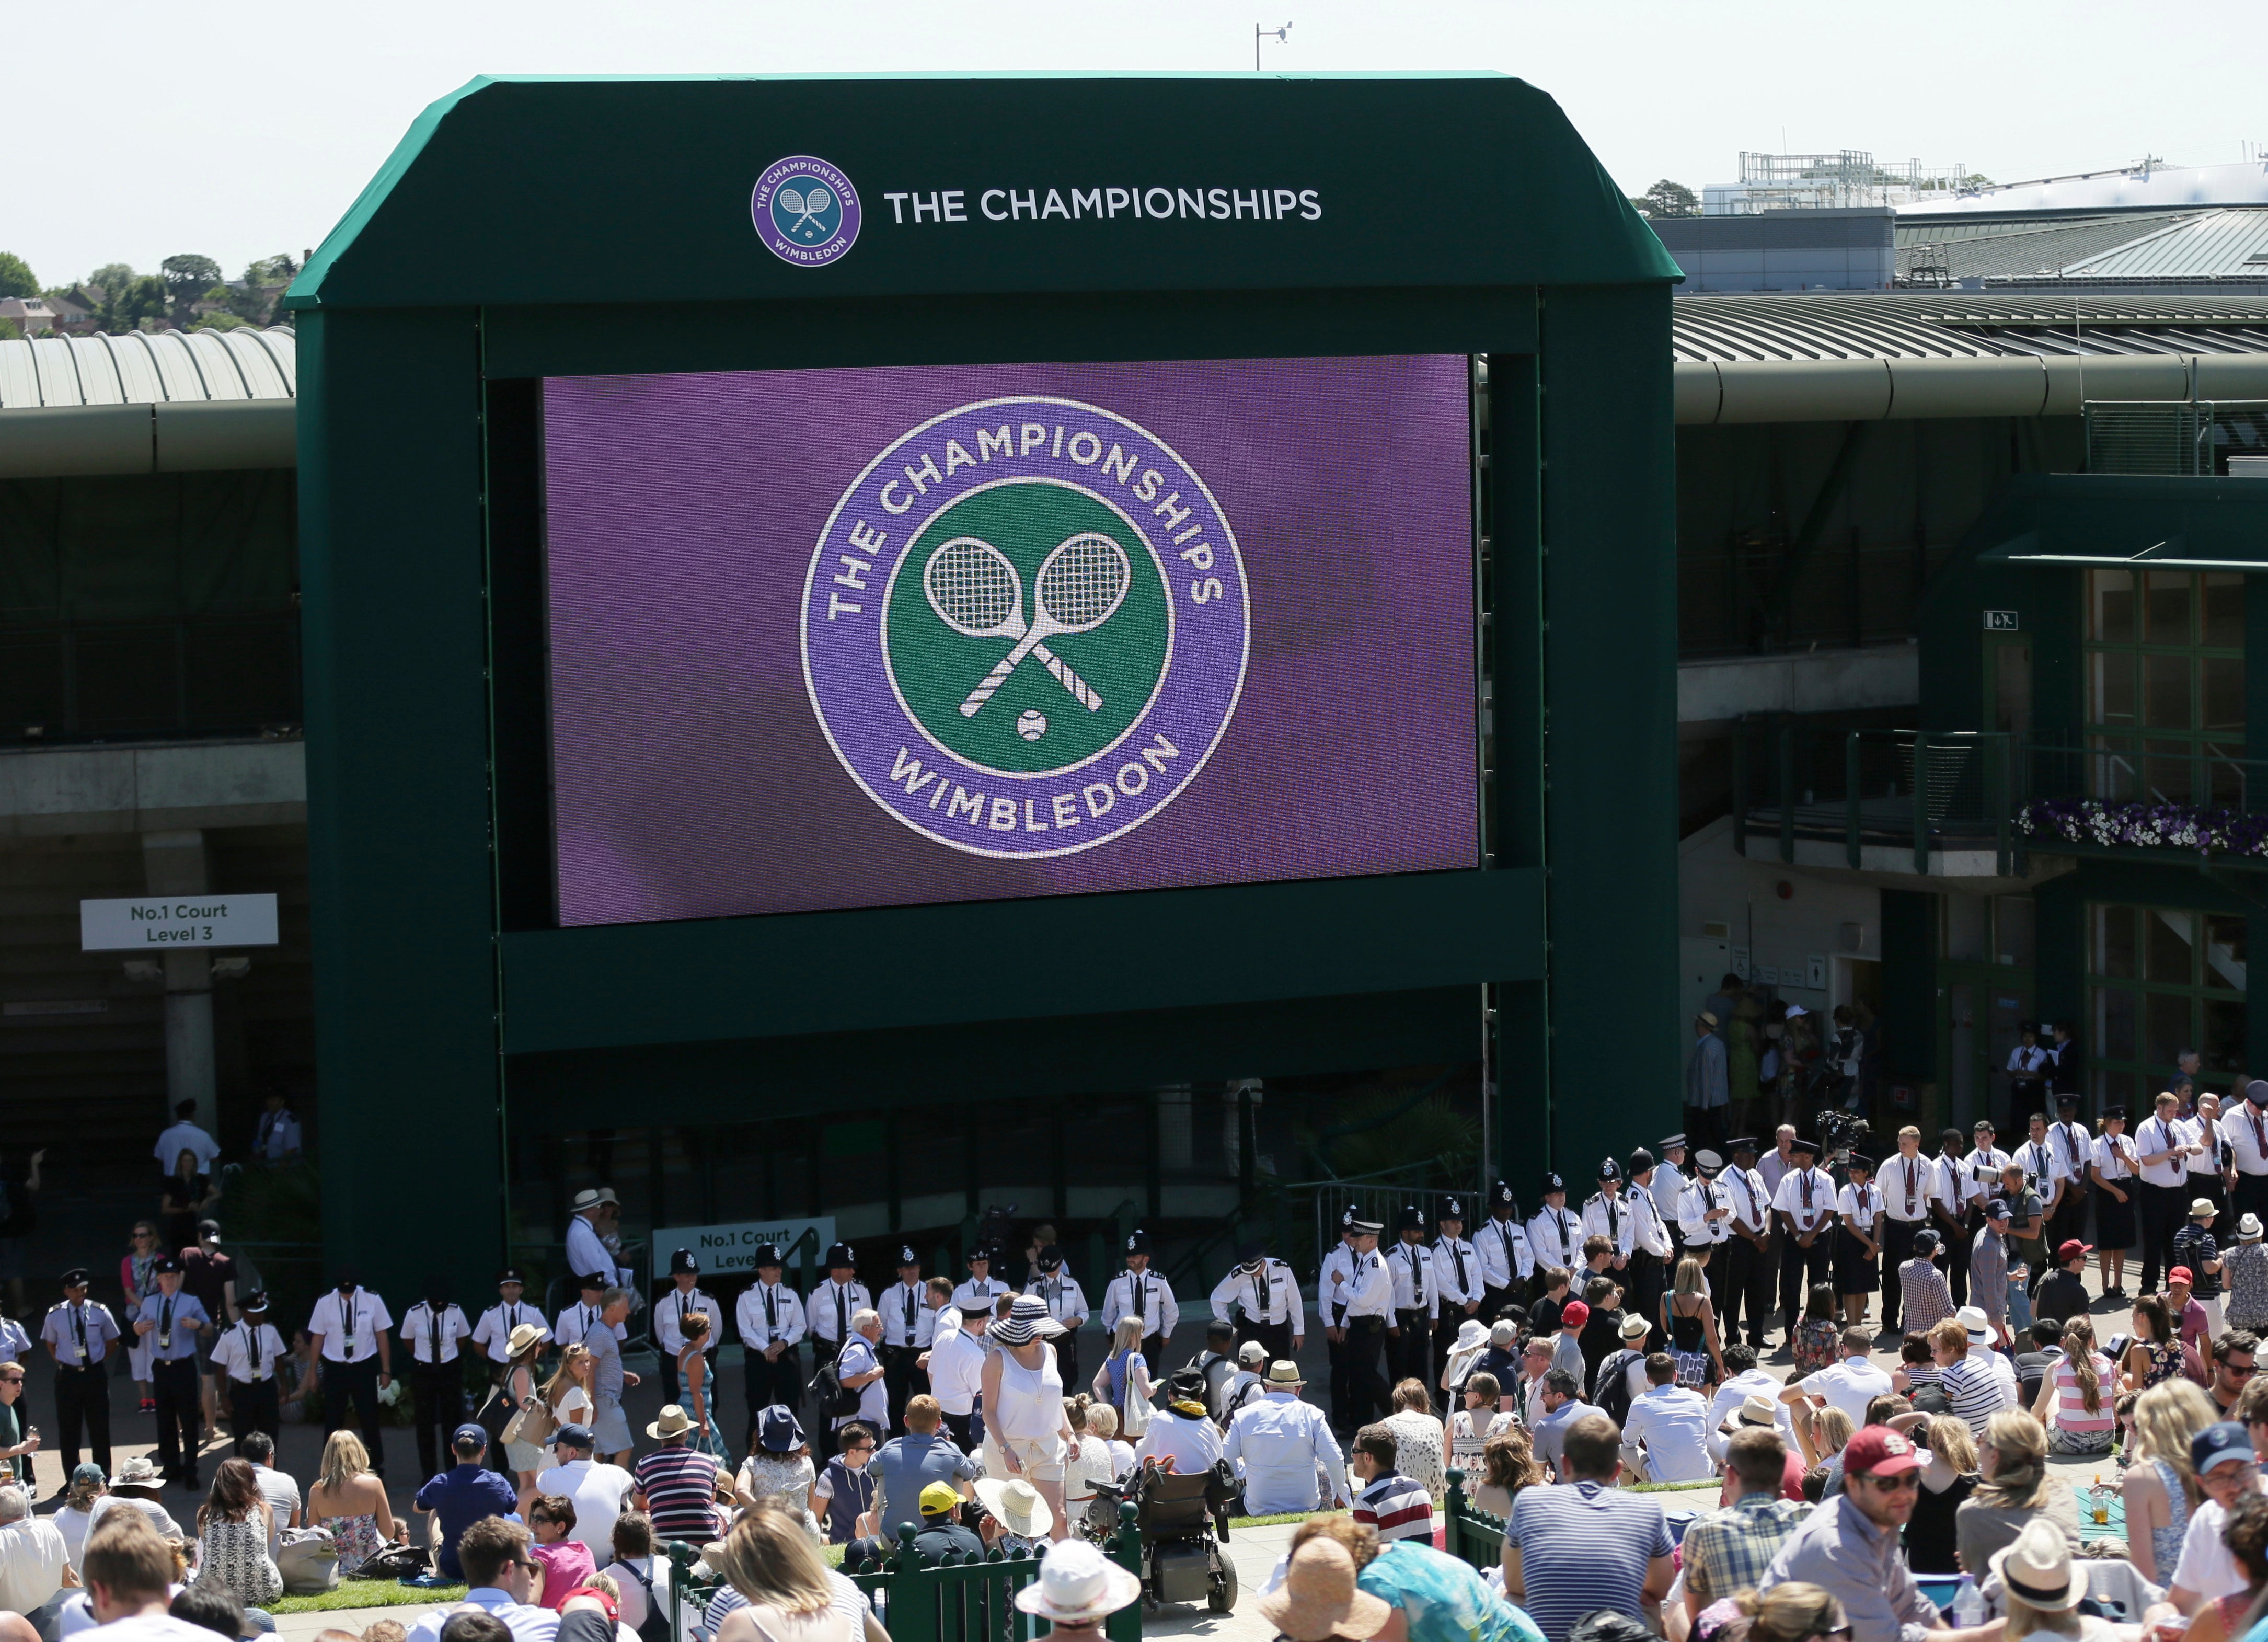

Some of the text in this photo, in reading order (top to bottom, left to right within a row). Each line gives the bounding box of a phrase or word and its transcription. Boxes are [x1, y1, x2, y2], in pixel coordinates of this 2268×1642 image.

[757, 162, 854, 209] THE CHAMPIONSHIPS
[884, 187, 1322, 223] THE CHAMPIONSHIPS
[775, 236, 847, 261] WIMBLEDON
[827, 423, 1223, 621] THE CHAMPIONSHIPS
[889, 732, 1181, 832] WIMBLEDON
[131, 904, 227, 920] No.1 Court
[147, 926, 213, 942] Level 3
[700, 1228, 790, 1248] No.1 Court
[715, 1255, 755, 1268] Leve
